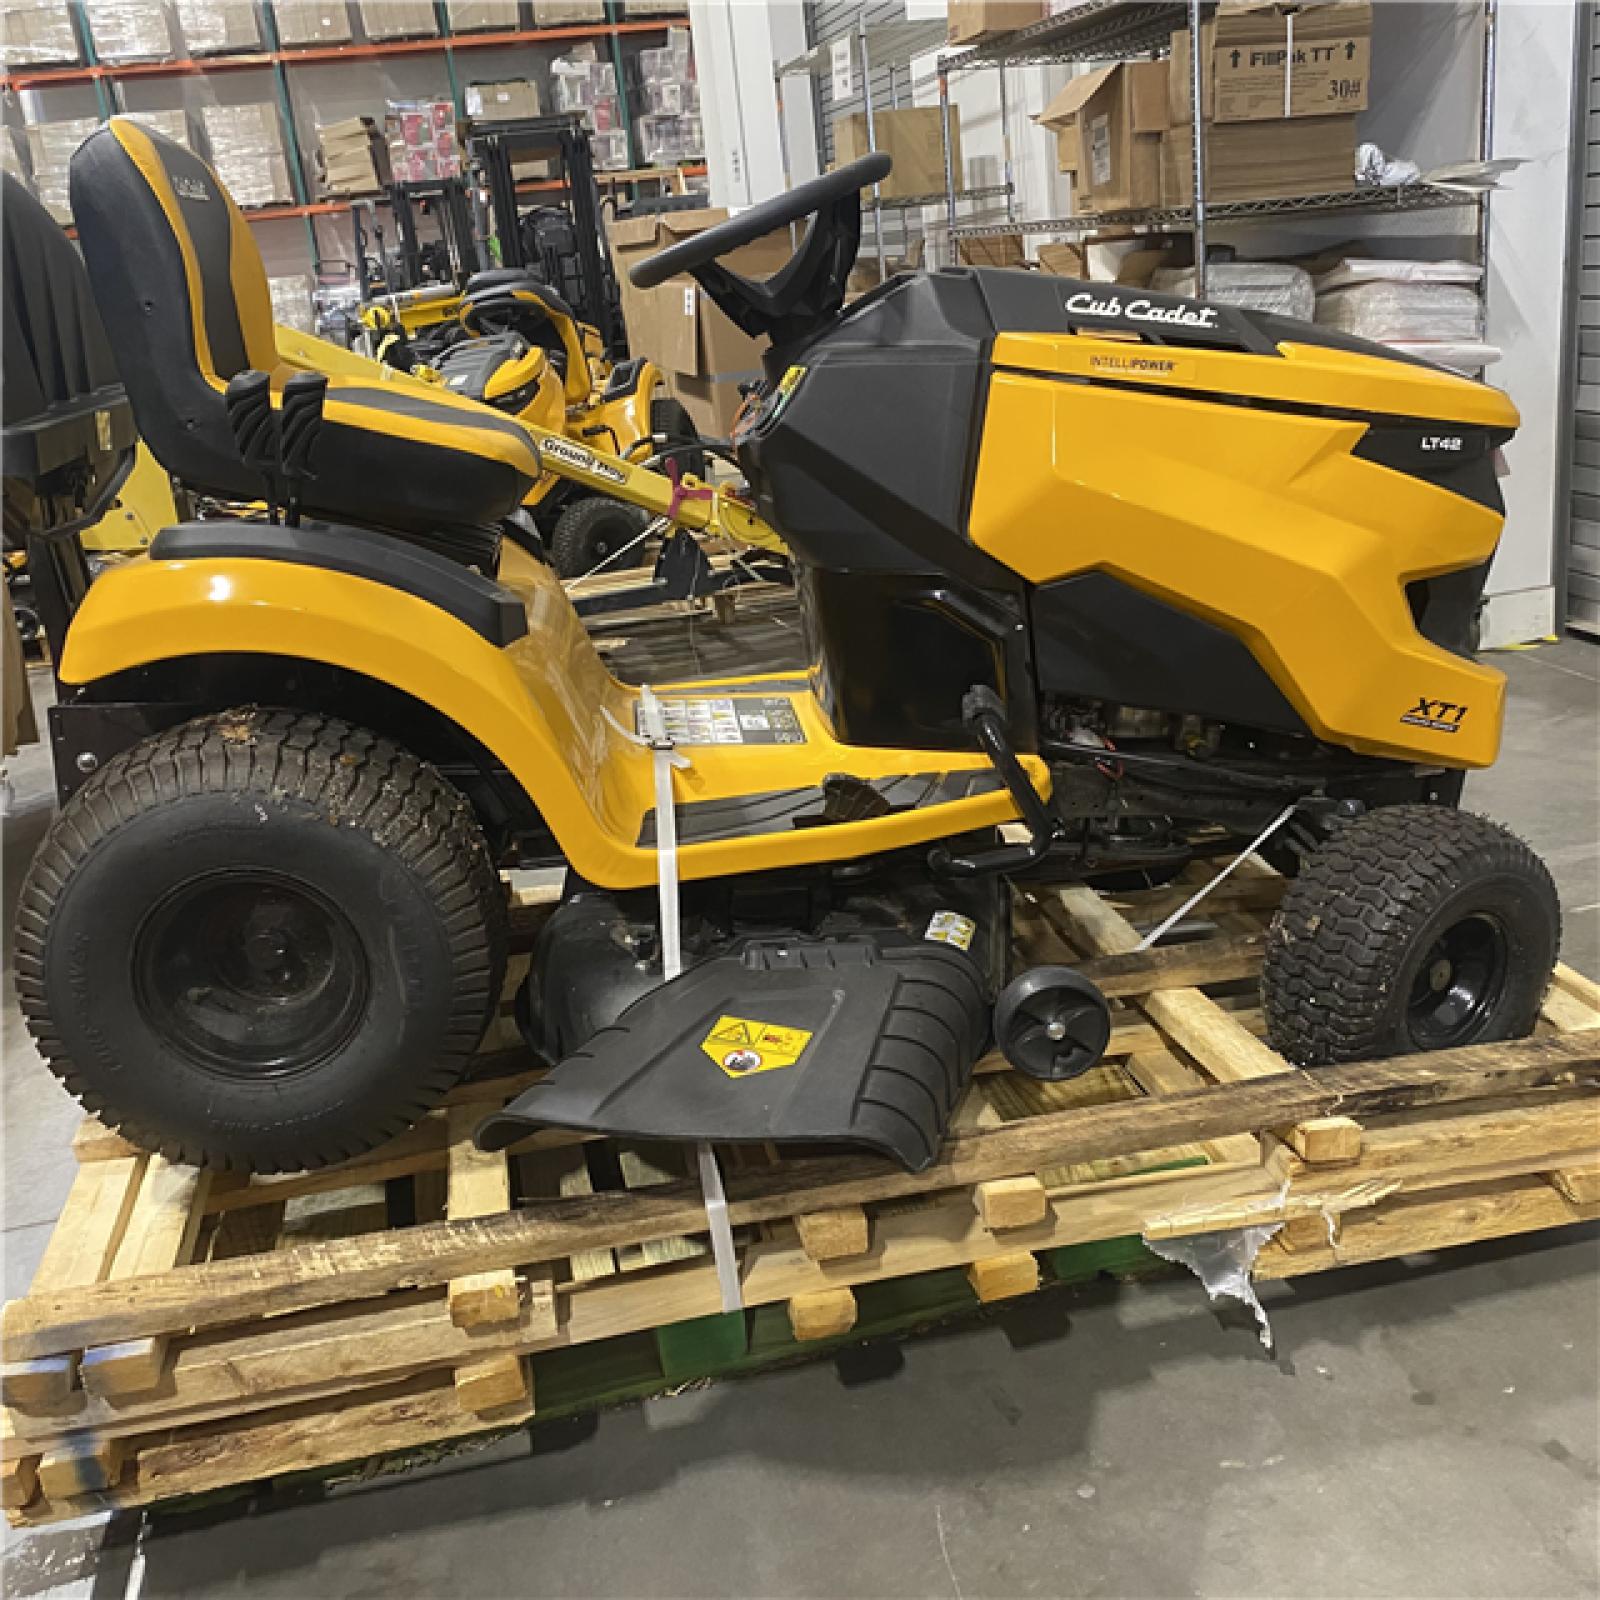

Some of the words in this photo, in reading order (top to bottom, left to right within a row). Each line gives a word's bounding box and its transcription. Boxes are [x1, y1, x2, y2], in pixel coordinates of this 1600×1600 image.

[1065, 292, 1121, 317] Cub
[1125, 300, 1218, 328] Cadet
[1090, 354, 1175, 372] INTELLIPOWER
[544, 439, 597, 466] Ground
[1421, 436, 1463, 451] LT42
[1408, 696, 1468, 723] XT1
